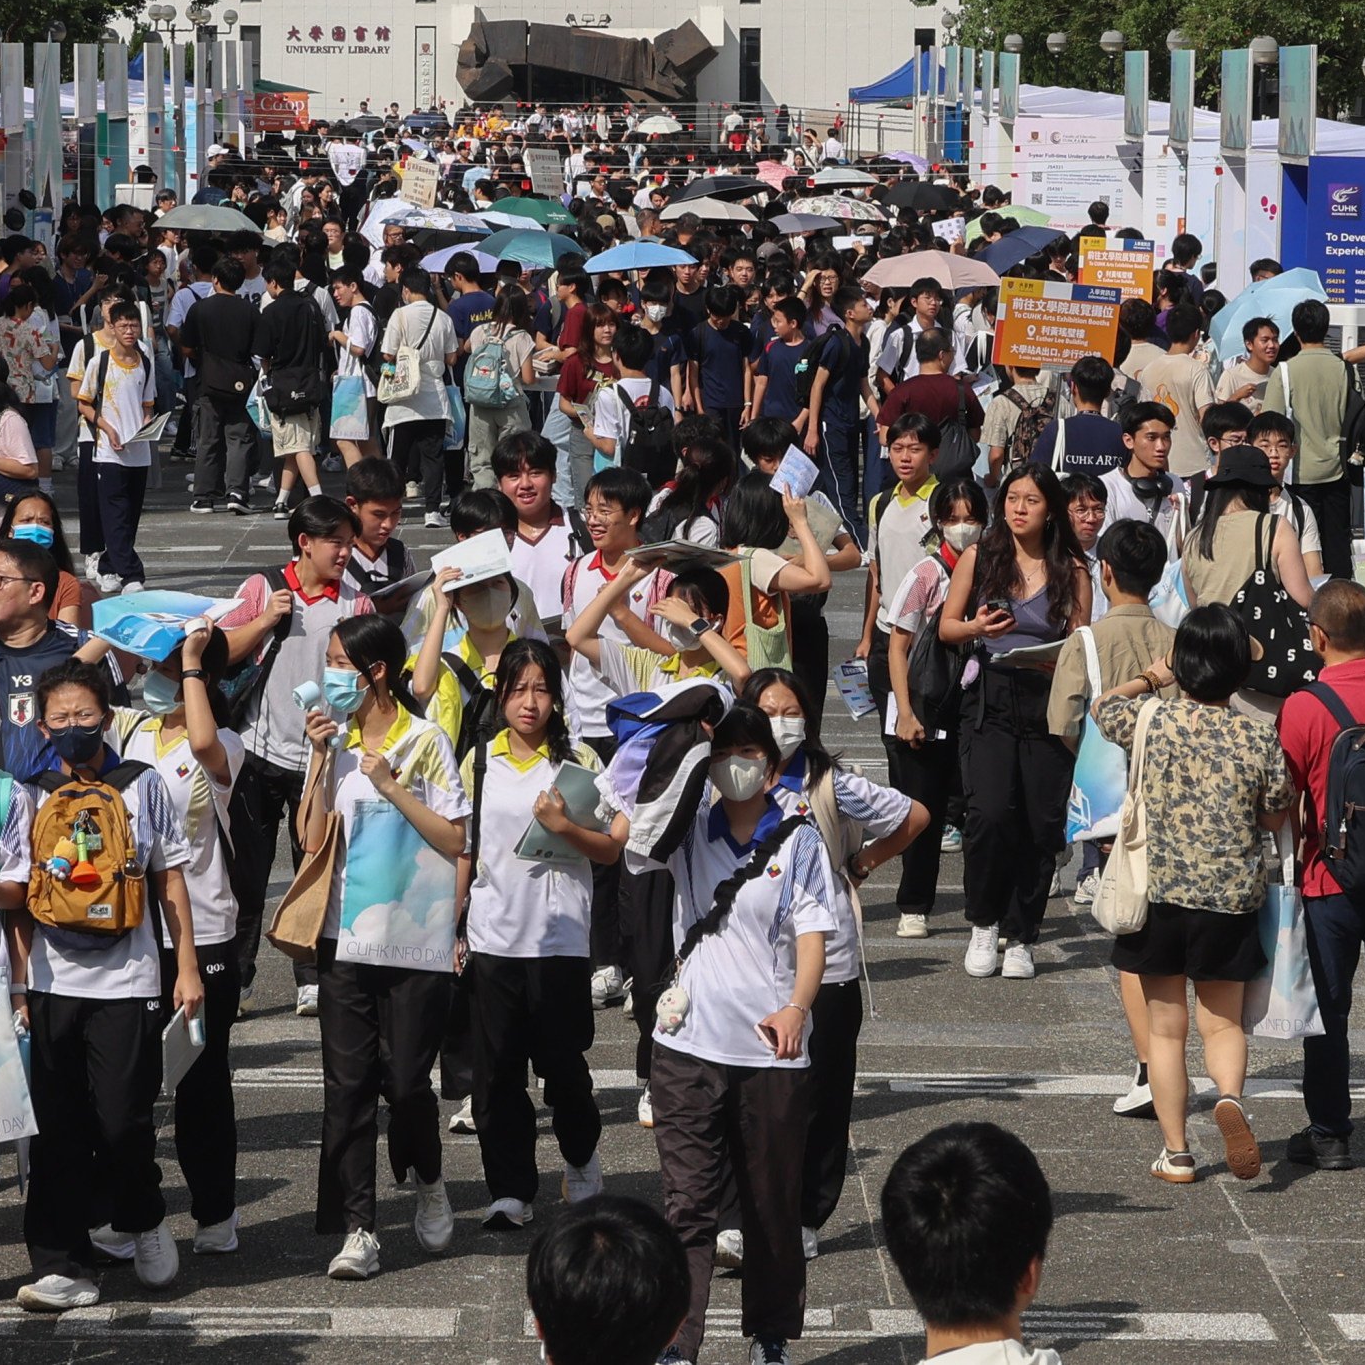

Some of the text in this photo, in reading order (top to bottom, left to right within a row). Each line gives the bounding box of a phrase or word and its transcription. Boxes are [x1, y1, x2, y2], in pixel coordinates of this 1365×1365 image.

[286, 25, 391, 42] 大學圖書館
[285, 46, 391, 54] UNIVERSITY LIBRARY
[1331, 204, 1358, 212] CUHK
[1326, 233, 1338, 242] To
[1089, 288, 1116, 296] 入學資訊日
[1012, 297, 1114, 319] 前往文學院展覽攤位
[1022, 312, 1042, 321] CUHK
[1042, 314, 1056, 322] Arts
[1056, 315, 1088, 325] Exhibition
[1088, 318, 1110, 327] Booths
[1036, 334, 1088, 347] Esther Lee Building
[1065, 454, 1123, 466] CUHK ARTS
[1255, 570, 1265, 585] 8
[1253, 606, 1262, 620] 3
[1287, 648, 1296, 662] 5
[1268, 665, 1278, 679] 9
[1303, 669, 1315, 682] 4
[12, 675, 33, 688] Y-3
[346, 941, 450, 963] CUHK INFO DAY
[206, 963, 225, 974] QOS
[1265, 1018, 1290, 1032] INFO
[1294, 1019, 1315, 1033] DAY
[2, 1115, 26, 1134] DAY
